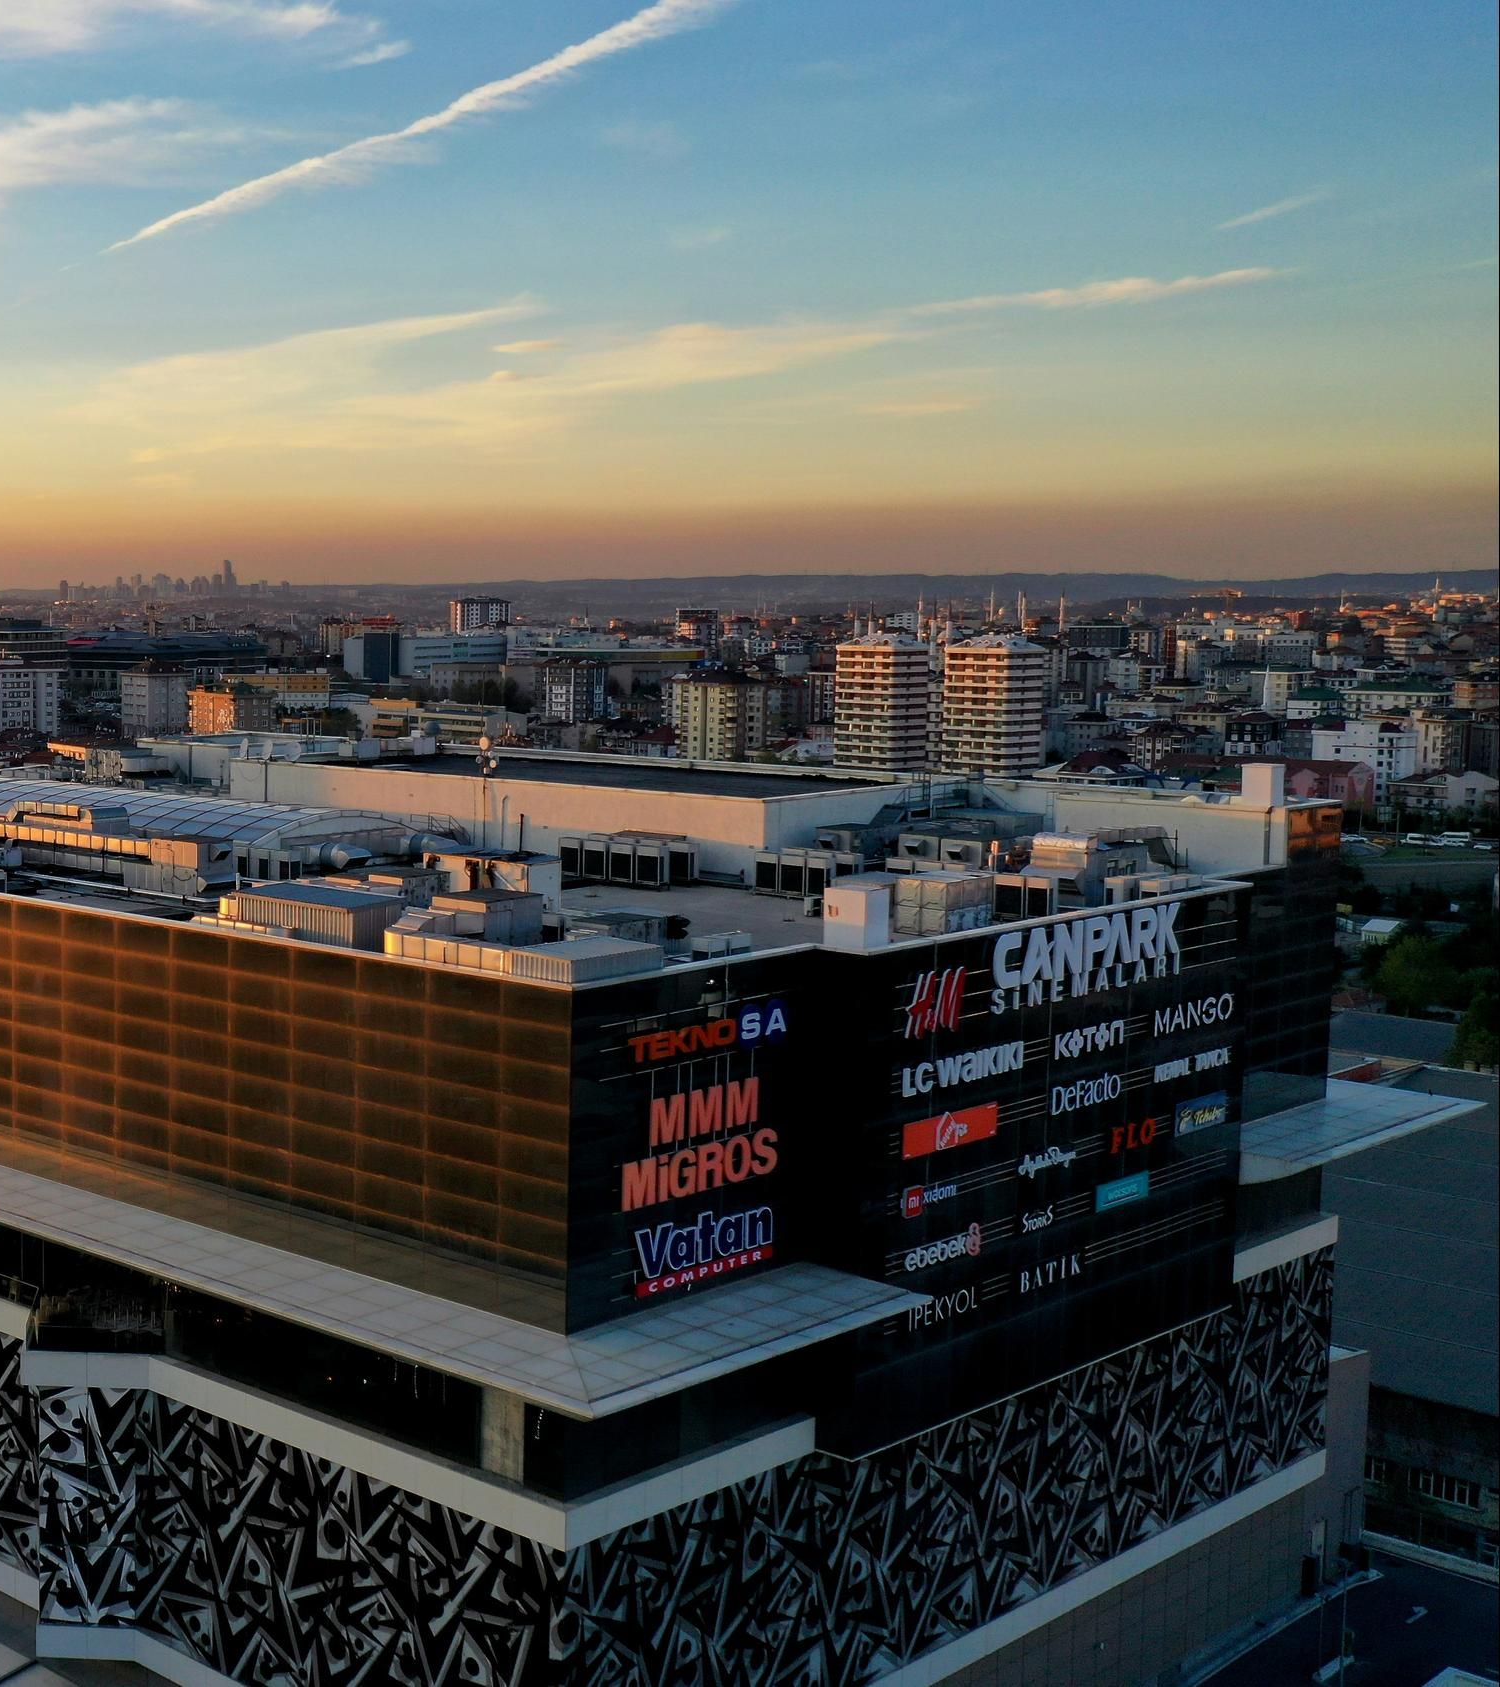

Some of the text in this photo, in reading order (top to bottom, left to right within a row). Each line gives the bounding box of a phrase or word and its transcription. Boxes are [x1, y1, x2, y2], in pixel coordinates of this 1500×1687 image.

[992, 902, 1181, 990] CANPARK
[905, 966, 966, 1040] H&M
[1154, 993, 1233, 1037] MANGO
[902, 1062, 934, 1098] LC
[1051, 1072, 1121, 1116] DeFacto
[650, 1076, 759, 1148] MMM
[1110, 1117, 1158, 1154] FLO
[635, 1206, 773, 1279] Vatan
[904, 1235, 967, 1271] ebebek
[648, 1251, 763, 1292] COMPUTER
